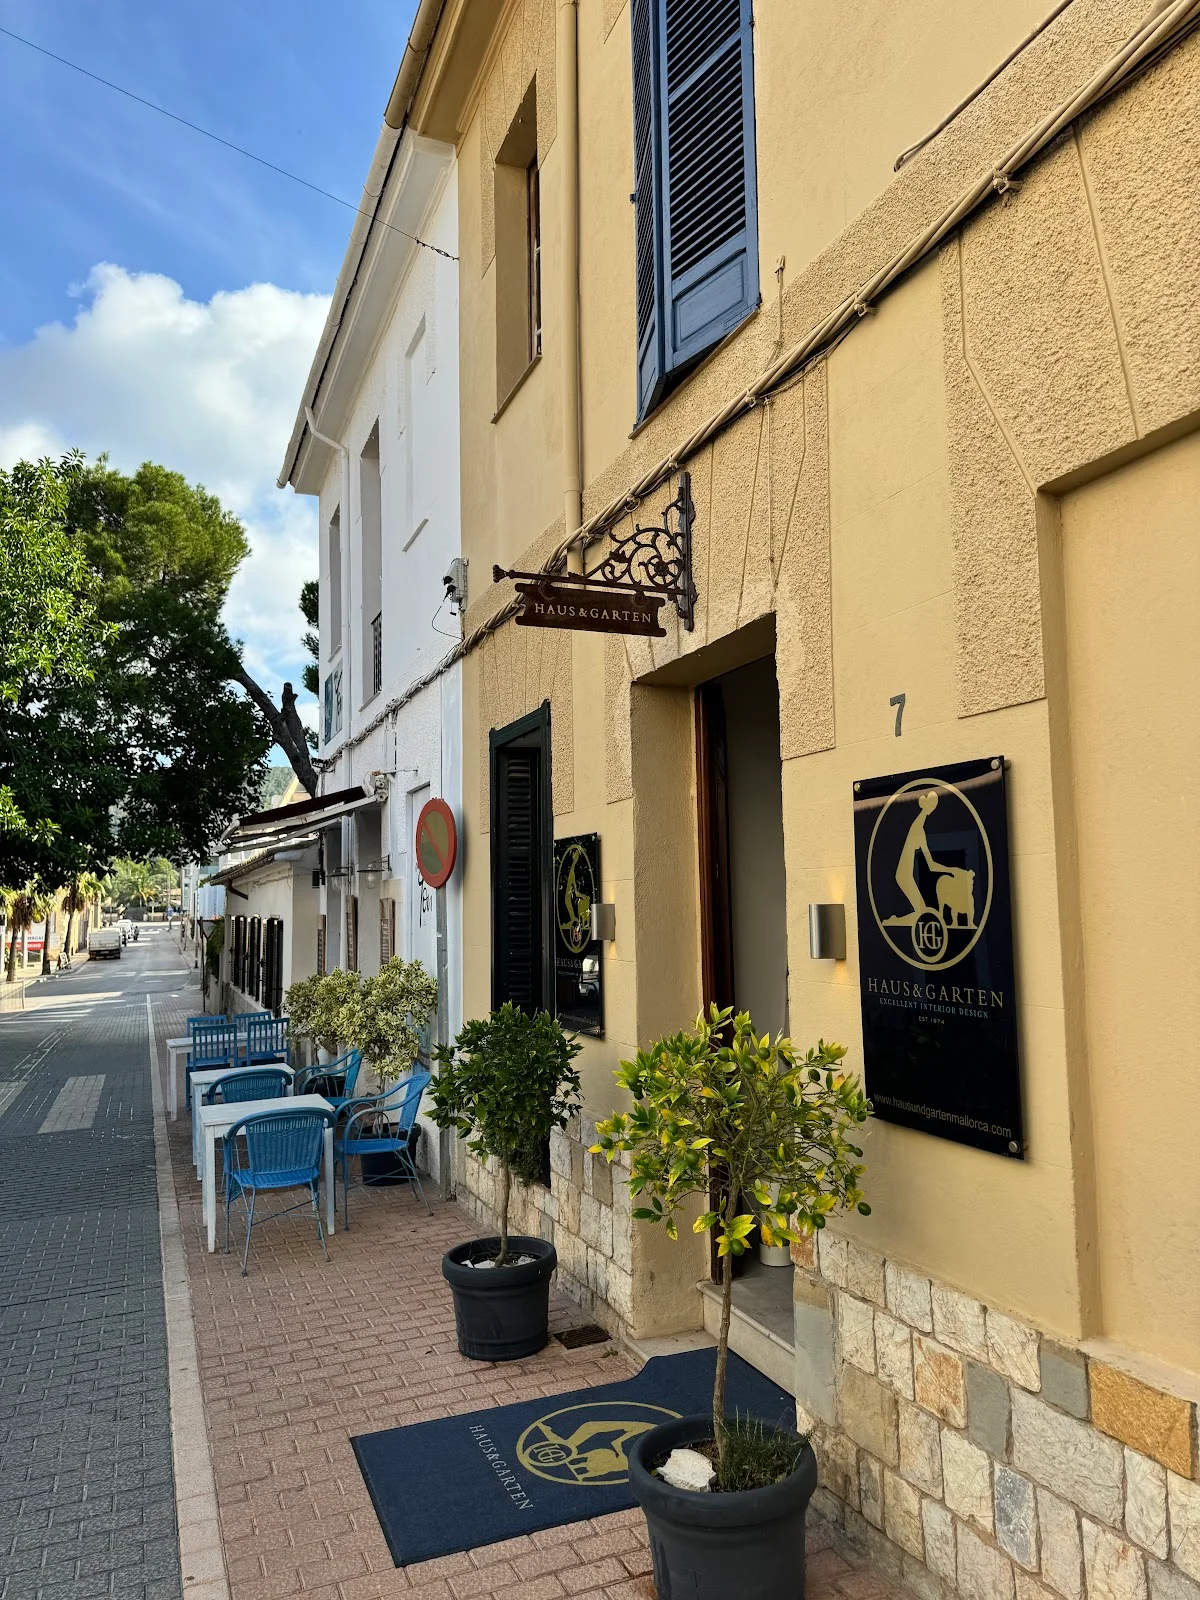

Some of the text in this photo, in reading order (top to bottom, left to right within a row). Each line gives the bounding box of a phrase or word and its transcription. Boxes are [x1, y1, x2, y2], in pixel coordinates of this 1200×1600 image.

[534, 603, 652, 623] HAUS&GARTEN
[889, 692, 906, 737] 7
[867, 977, 1004, 1008] HAUS&GARTEN
[879, 997, 989, 1019] EXCELLENT INTERIOR DESIGN
[873, 1093, 1012, 1139] www.hausundgartenmallorca.com
[469, 1424, 534, 1510] HAUS&GARTEN
